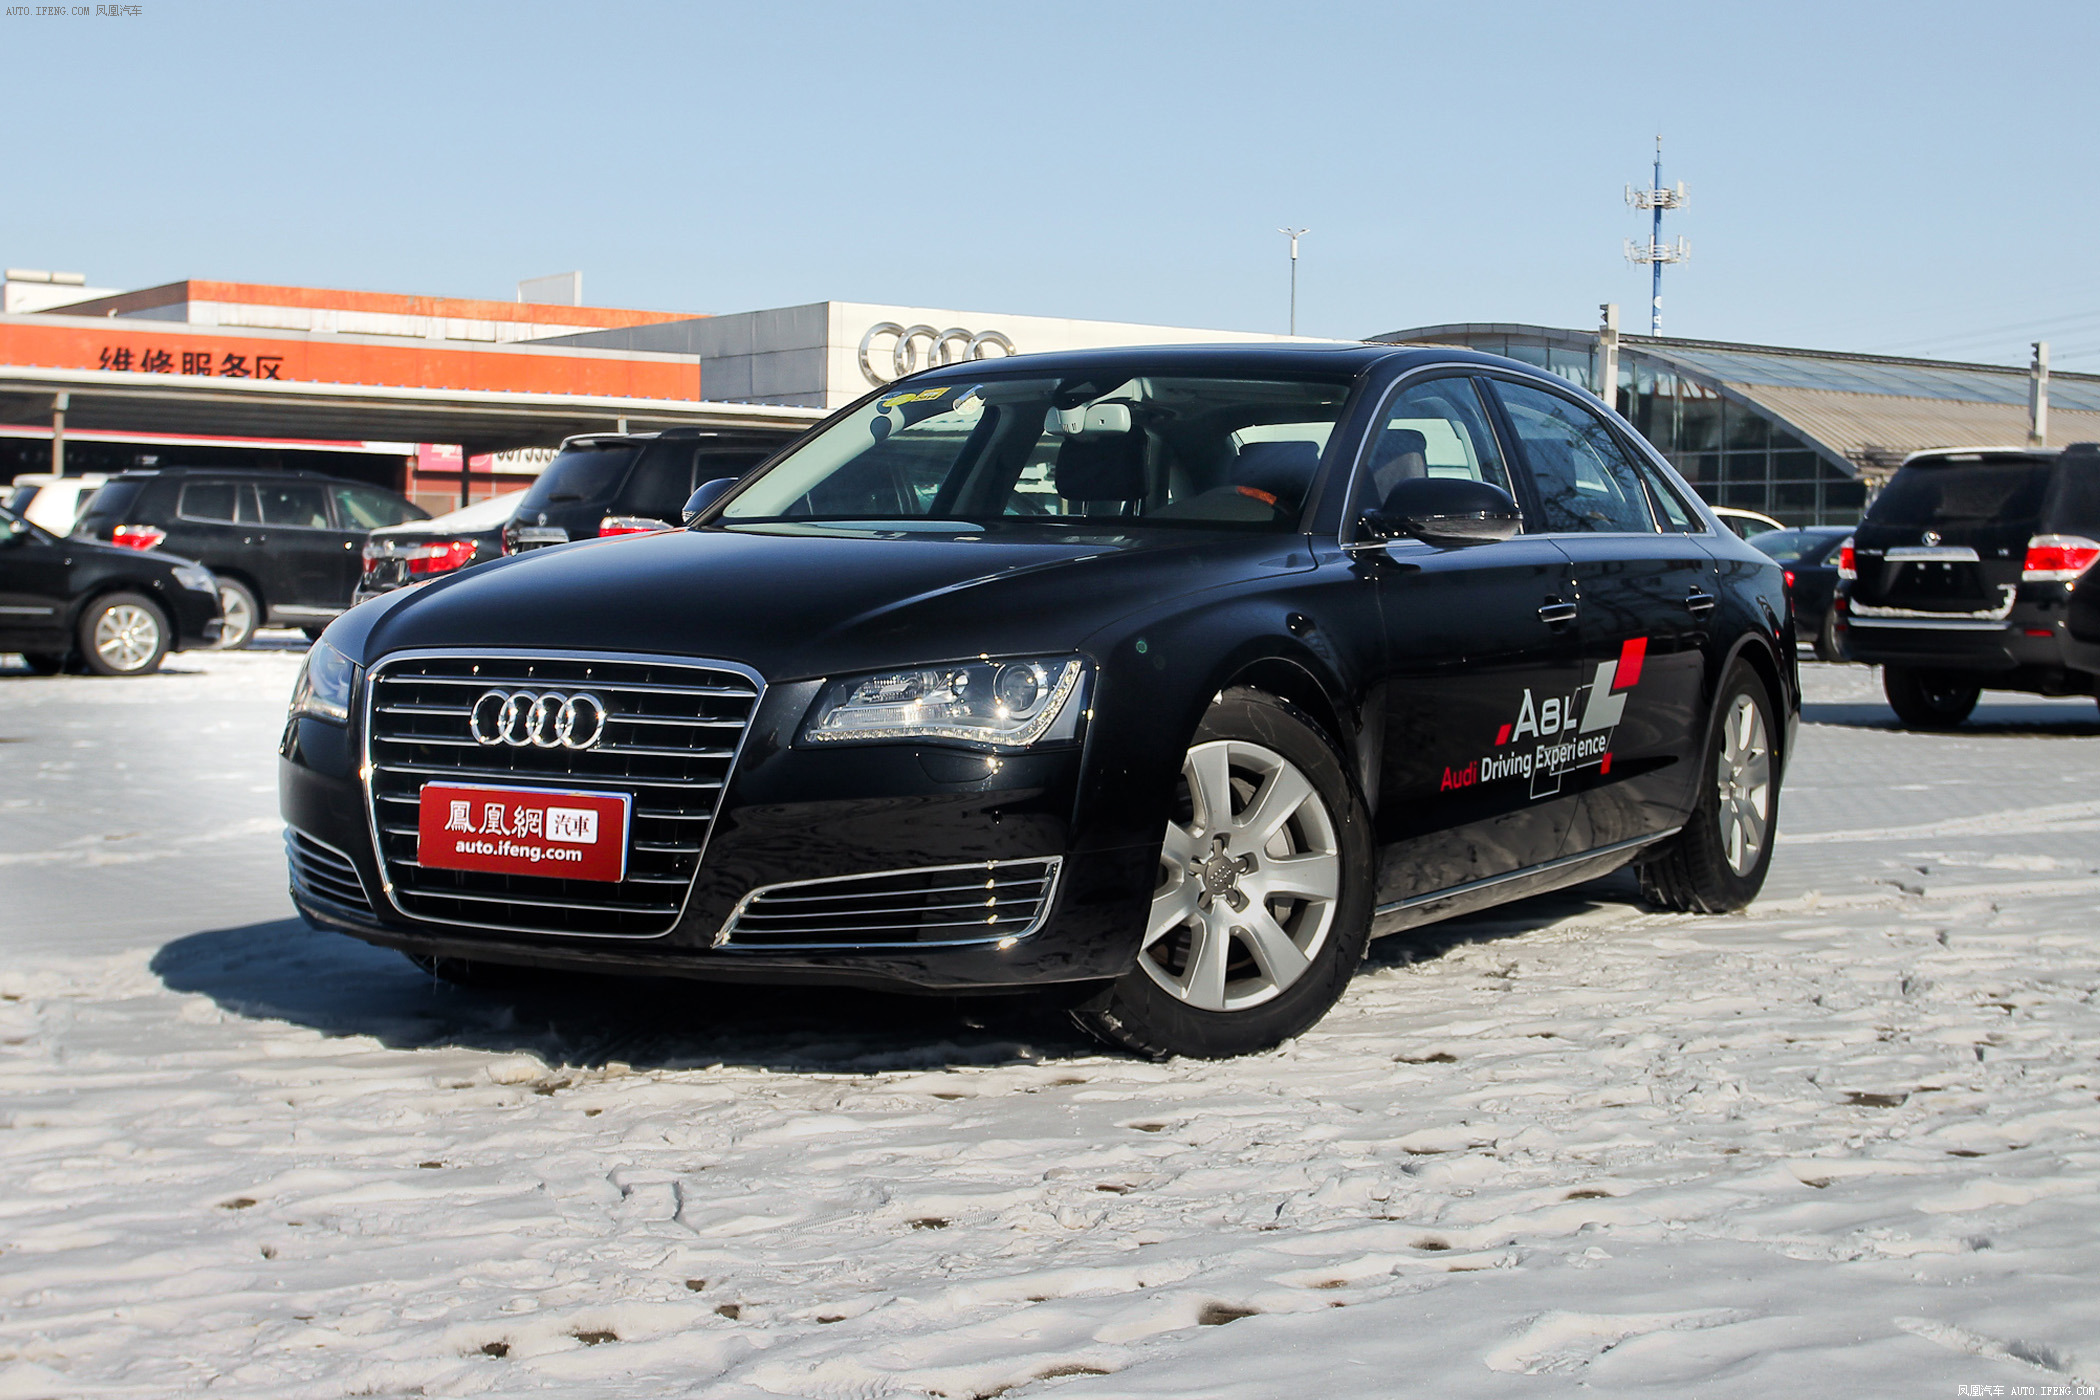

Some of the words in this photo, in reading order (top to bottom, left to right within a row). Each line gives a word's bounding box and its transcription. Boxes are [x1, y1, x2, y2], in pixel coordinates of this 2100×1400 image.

[98, 346, 284, 381] 维修服务区
[1511, 688, 1577, 743] A8L
[1440, 760, 1478, 792] Audi
[1481, 751, 1532, 783] Driving
[1535, 734, 1607, 771] Experience
[455, 839, 583, 863] auto.ifeng.com
